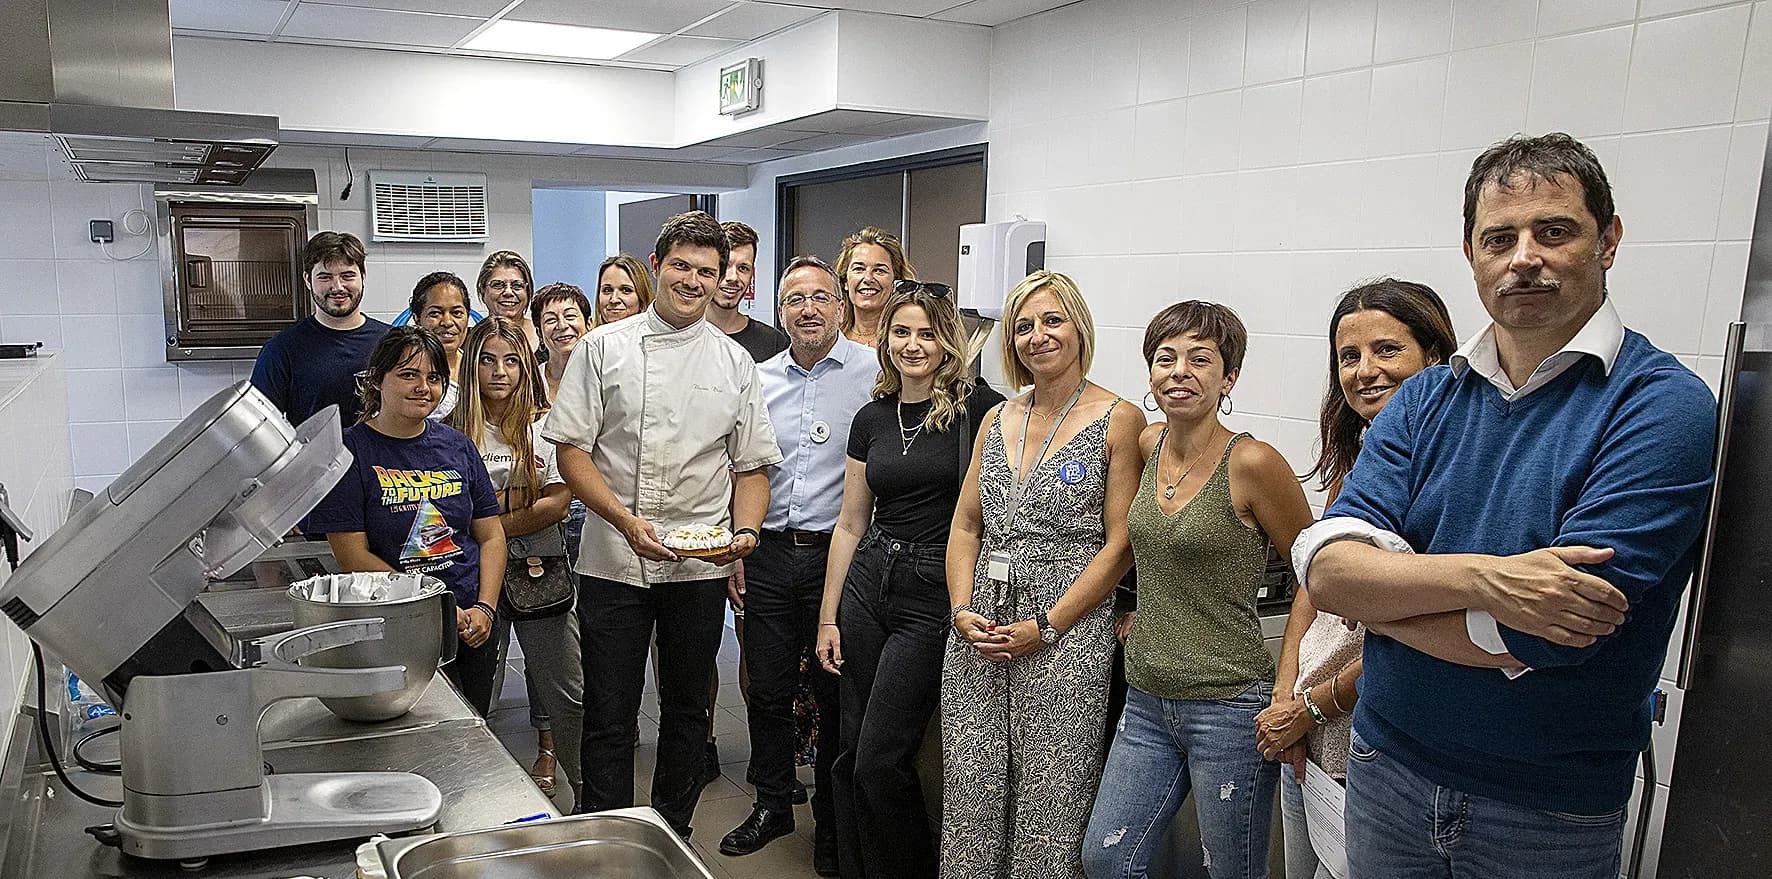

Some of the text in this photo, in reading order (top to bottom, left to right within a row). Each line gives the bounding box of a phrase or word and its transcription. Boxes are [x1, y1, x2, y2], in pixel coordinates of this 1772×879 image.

[372, 465, 462, 488] BACK
[381, 487, 396, 497] TO
[397, 481, 462, 504] FUTURE
